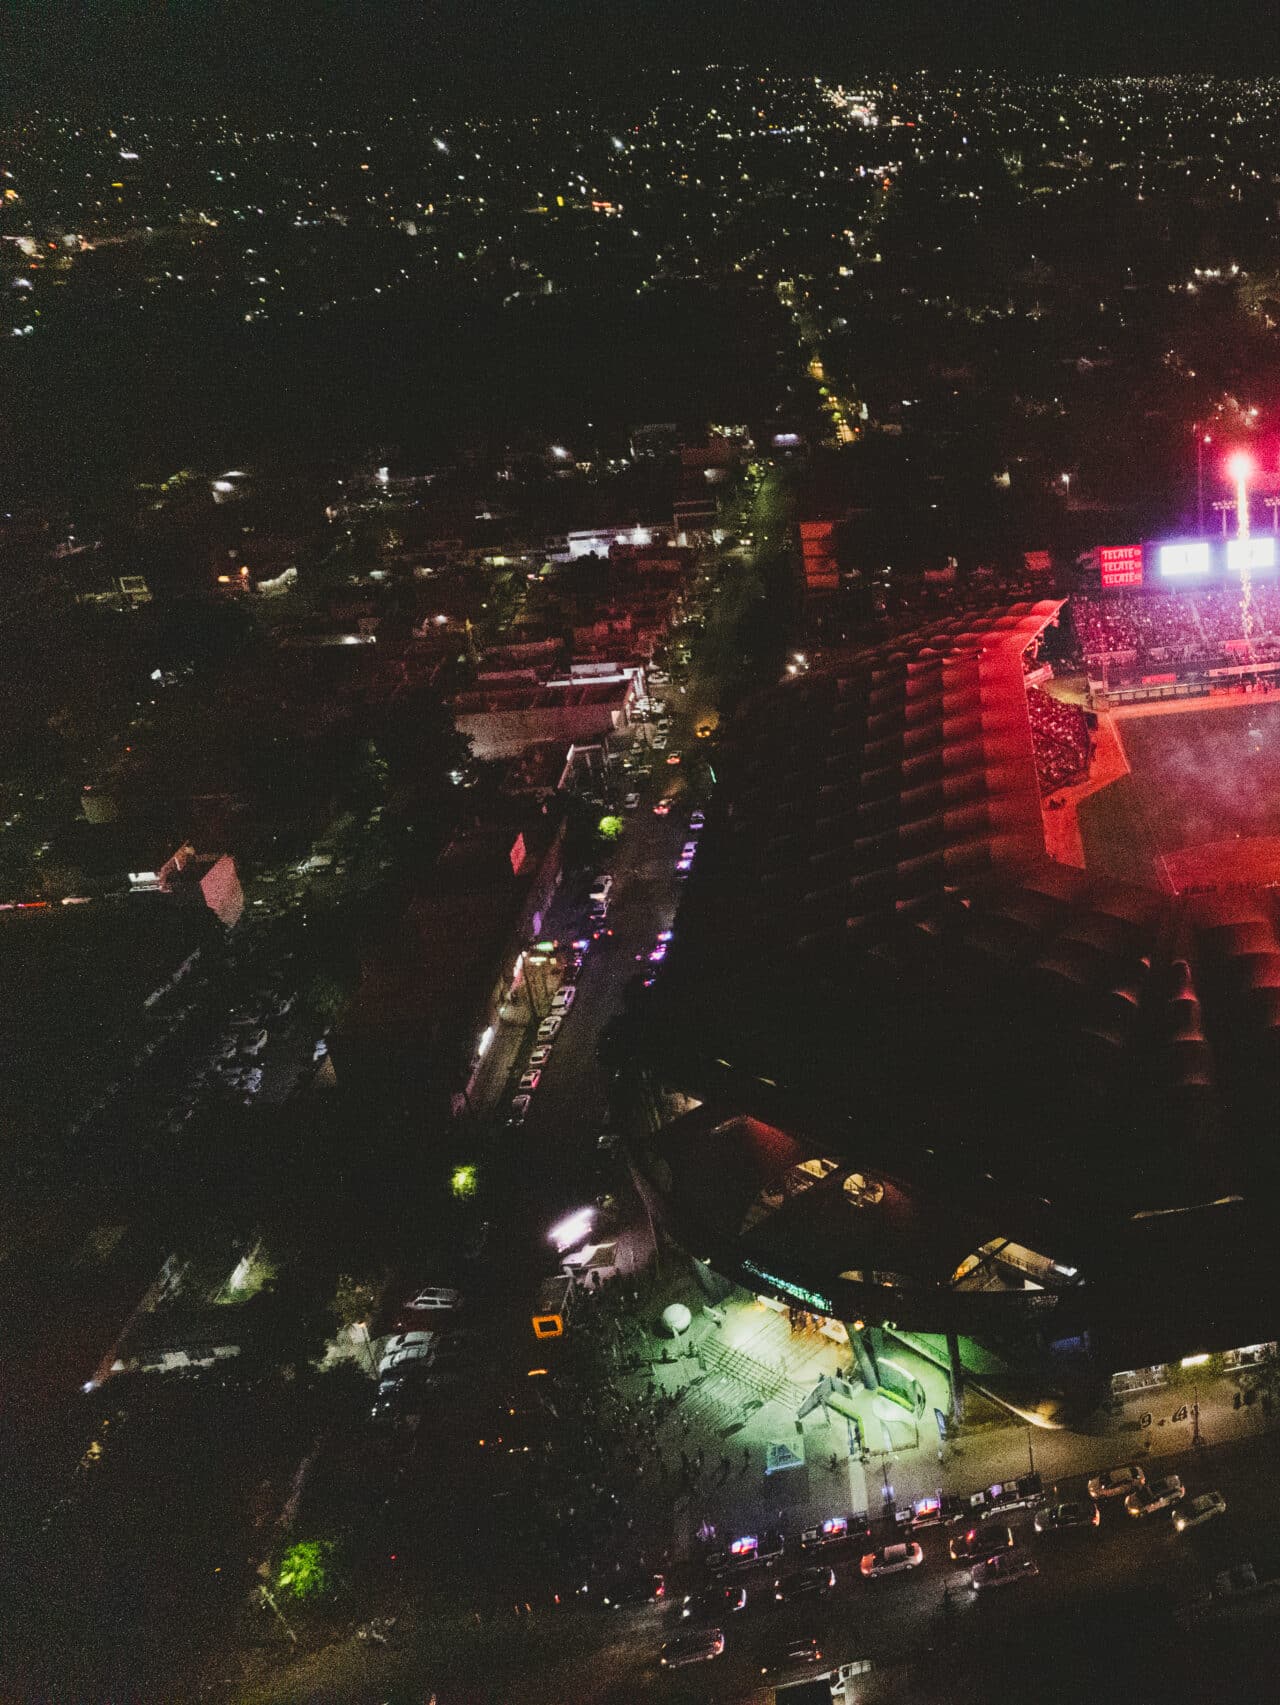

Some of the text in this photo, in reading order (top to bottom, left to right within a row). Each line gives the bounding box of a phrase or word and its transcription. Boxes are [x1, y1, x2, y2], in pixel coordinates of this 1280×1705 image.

[1102, 548, 1134, 560] TECATE
[1103, 560, 1135, 572] TECATE
[1103, 572, 1135, 584] TECATE
